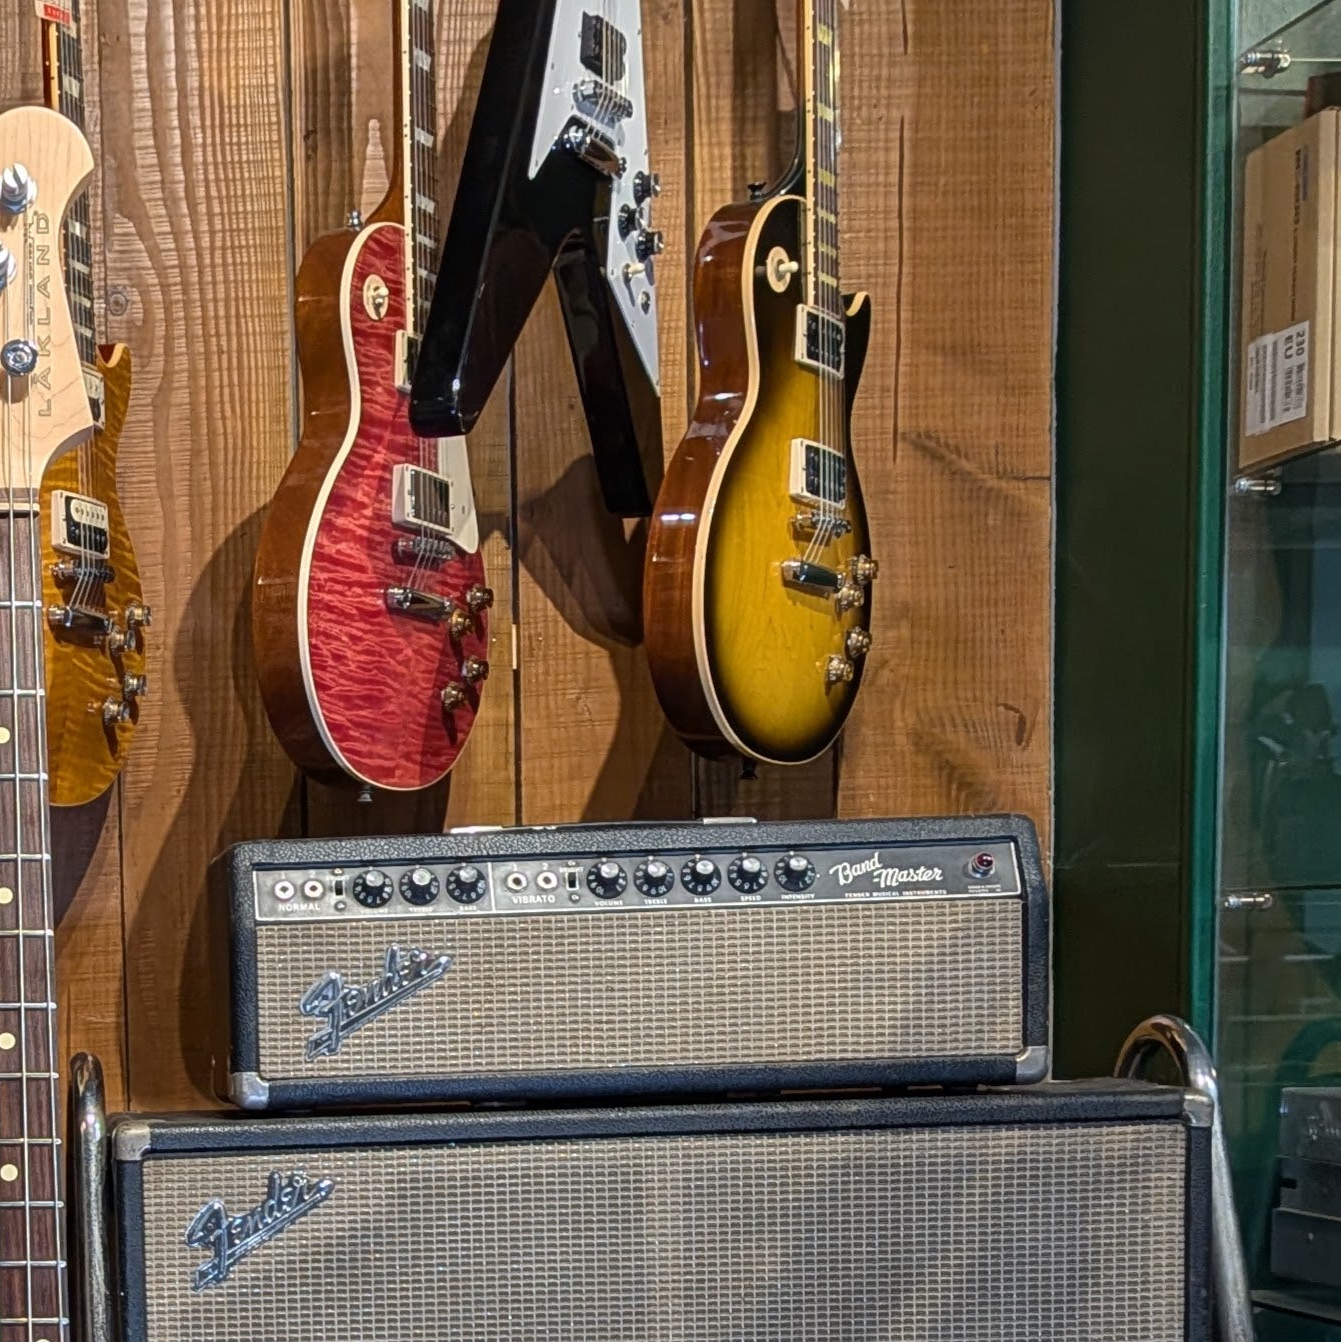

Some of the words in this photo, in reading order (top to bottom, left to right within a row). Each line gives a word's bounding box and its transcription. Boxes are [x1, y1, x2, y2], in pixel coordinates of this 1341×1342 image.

[829, 851, 883, 886] Band
[512, 895, 555, 904] VIBRATO
[278, 903, 321, 912] NORMAL
